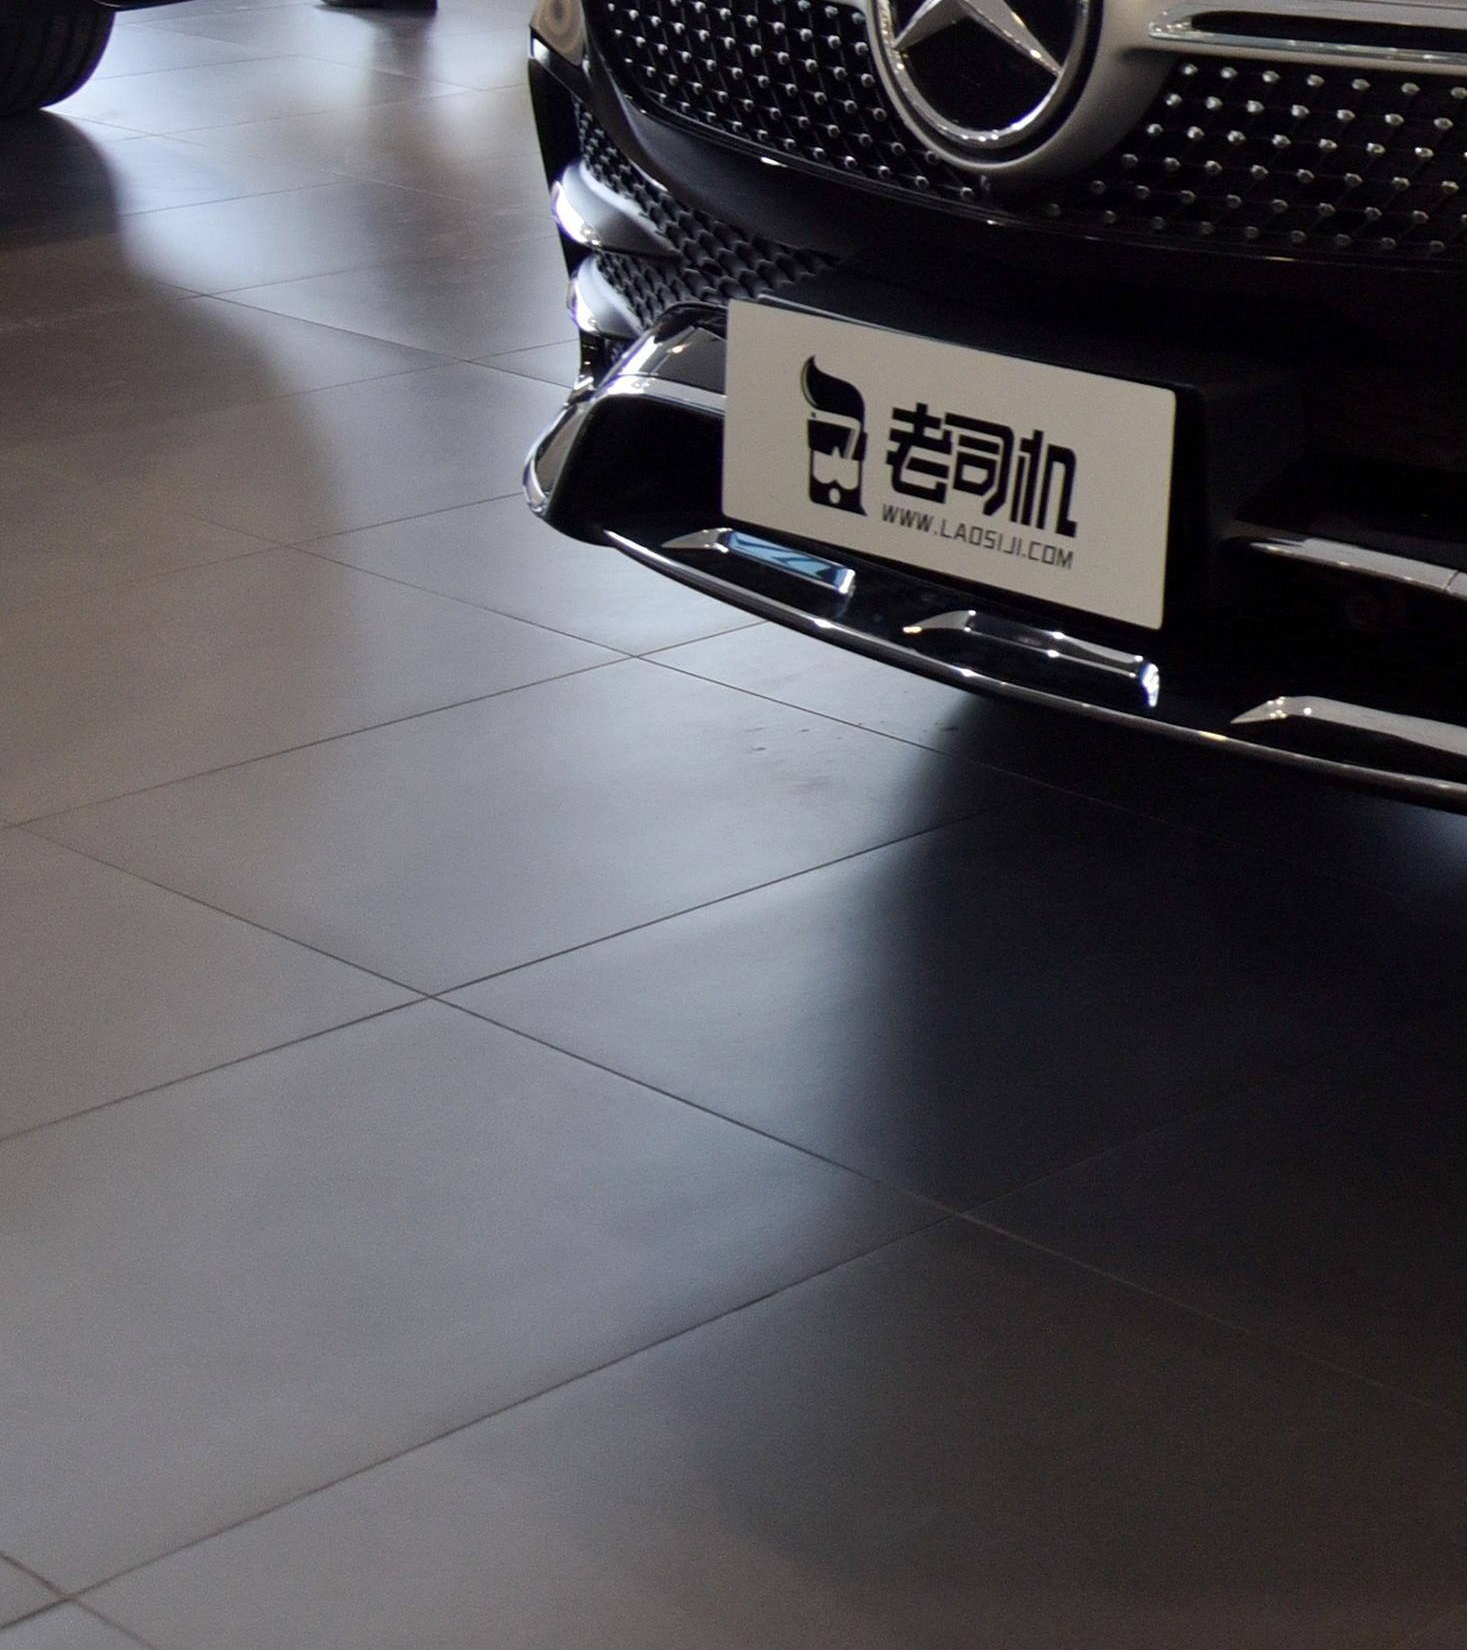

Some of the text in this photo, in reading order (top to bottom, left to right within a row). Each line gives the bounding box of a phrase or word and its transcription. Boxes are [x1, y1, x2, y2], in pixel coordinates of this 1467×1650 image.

[885, 401, 1078, 539] 老司机
[881, 502, 1075, 571] WWW.LAOSIJI.COM
